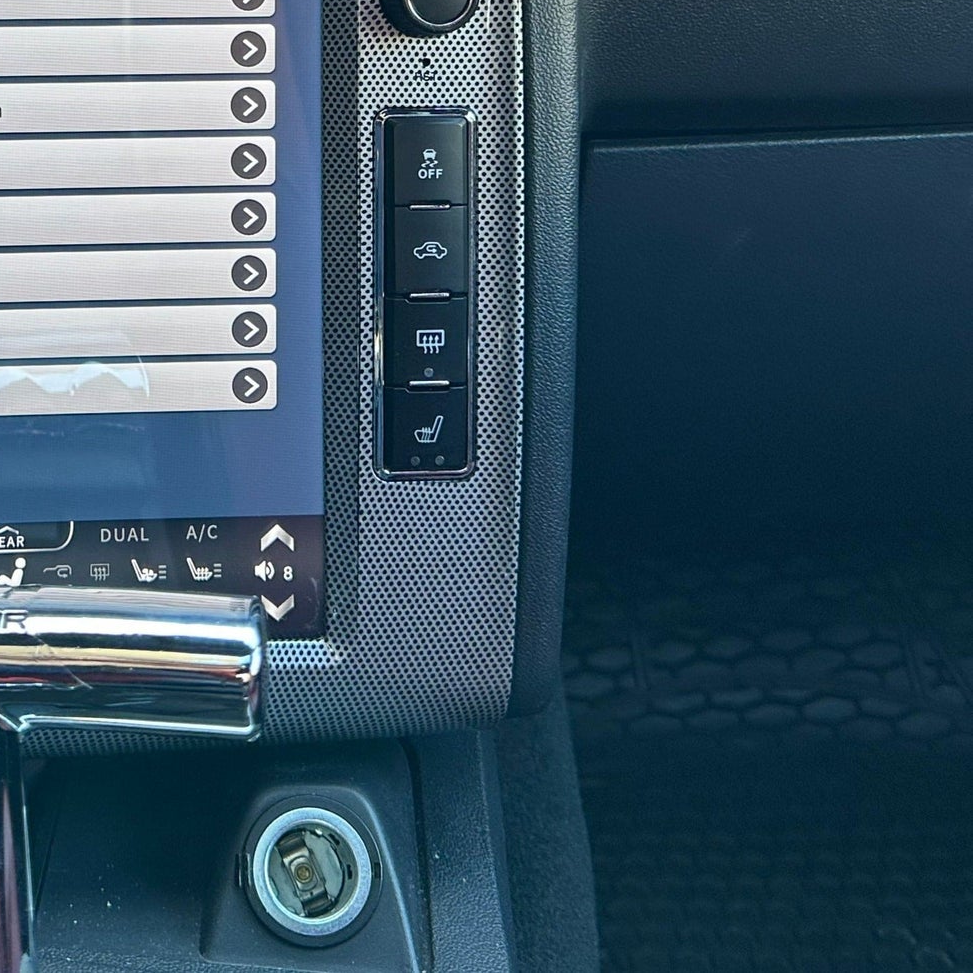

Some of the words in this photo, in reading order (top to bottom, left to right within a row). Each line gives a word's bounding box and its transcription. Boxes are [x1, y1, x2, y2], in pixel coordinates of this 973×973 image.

[417, 167, 443, 180] OFF
[99, 526, 150, 544] DUAL
[185, 522, 219, 541] A/C
[283, 565, 294, 582] 8
